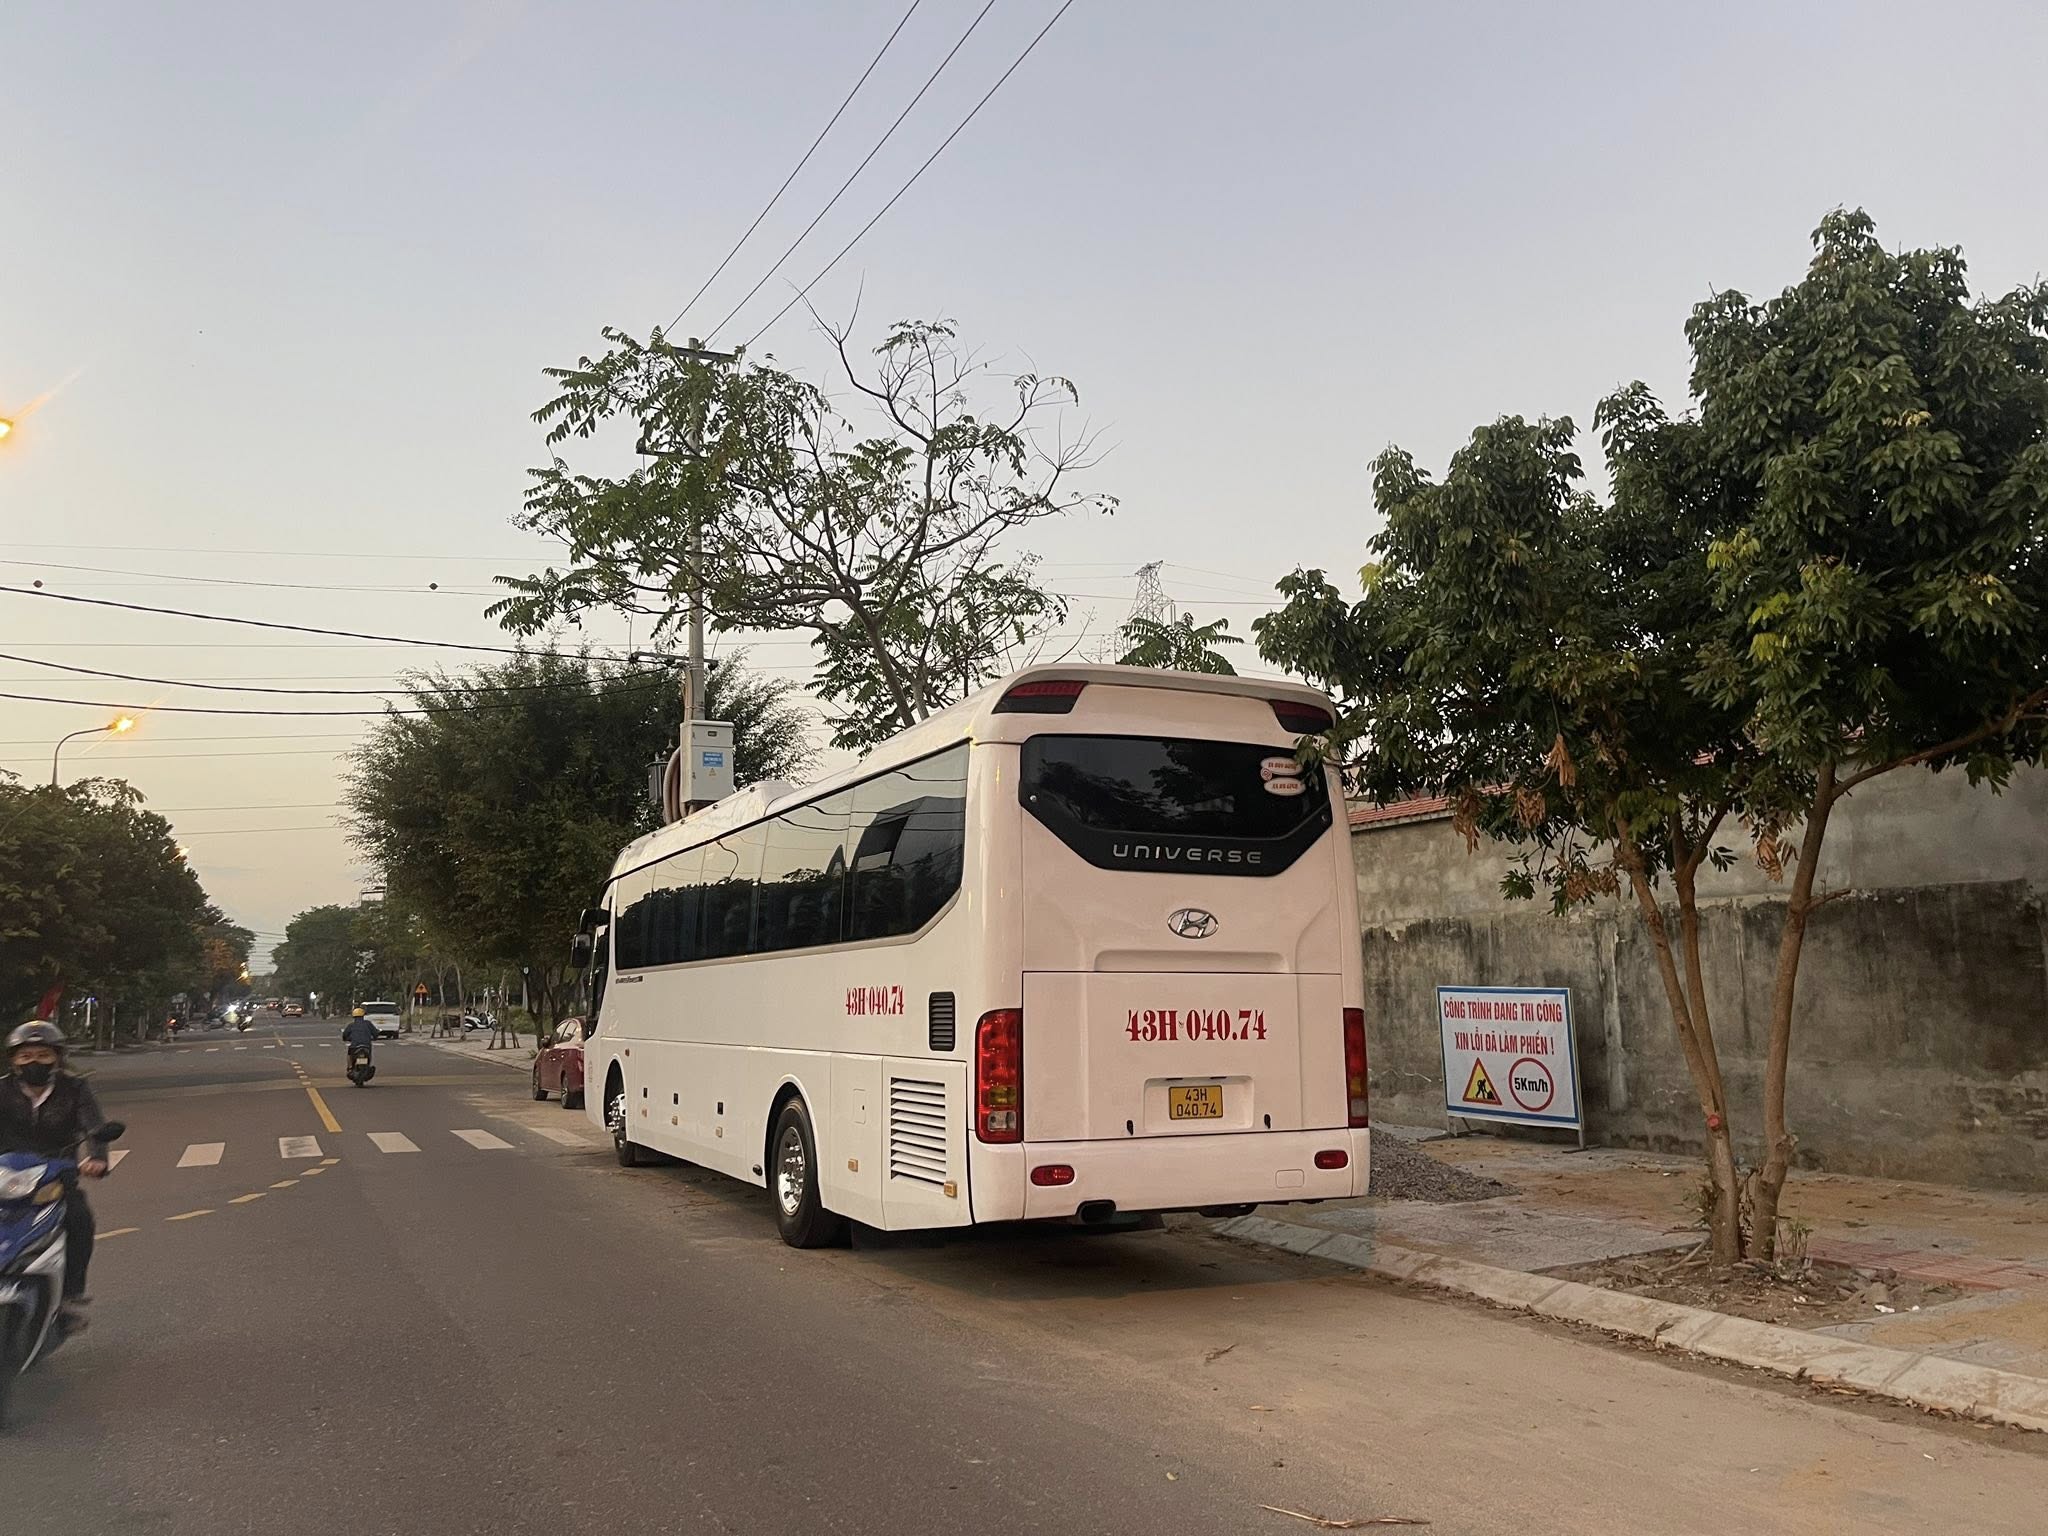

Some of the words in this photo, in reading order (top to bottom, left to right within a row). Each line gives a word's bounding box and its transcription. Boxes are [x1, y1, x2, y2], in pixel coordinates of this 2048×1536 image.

[1112, 844, 1262, 864] UNIVERSE
[1443, 996, 1466, 1019] CÔNG
[1467, 997, 1492, 1020] TRÌNH
[1520, 1002, 1534, 1022] THI
[1536, 999, 1563, 1023] CÔNG
[1454, 1031, 1469, 1050] XIN
[1470, 1026, 1484, 1052] LỖI
[1485, 1030, 1498, 1052] ĐÃ
[1499, 1030, 1518, 1053] LÀM
[1514, 1077, 1549, 1093] 5Km/h
[1185, 1088, 1208, 1101] 43H
[1176, 1103, 1217, 1117] 040.74
